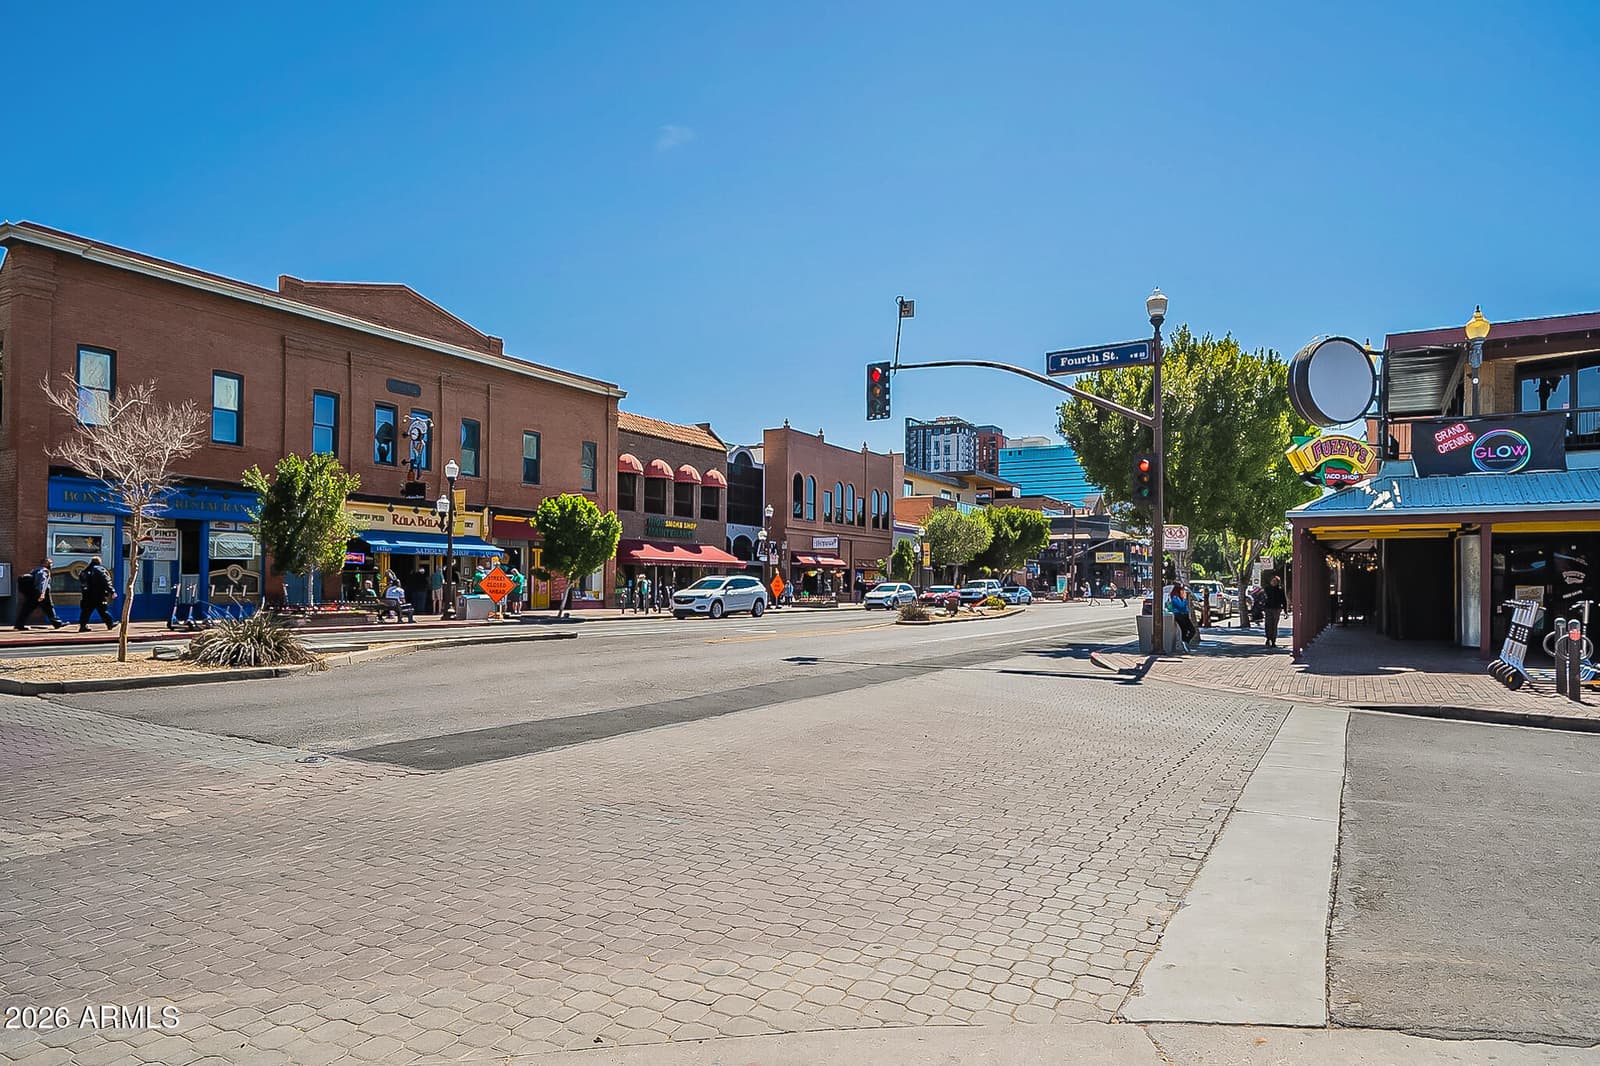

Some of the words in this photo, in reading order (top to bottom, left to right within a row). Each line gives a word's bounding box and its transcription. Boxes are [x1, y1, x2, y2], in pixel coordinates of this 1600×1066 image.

[1060, 353, 1099, 367] Fourth
[1102, 351, 1119, 361] St.
[1434, 423, 1466, 442] GRAND
[1312, 439, 1369, 463] FUZZY'S
[1437, 432, 1474, 454] OPENING
[1474, 445, 1527, 459] GLOW
[1324, 472, 1341, 480] TACO
[1342, 473, 1360, 481] SHOP
